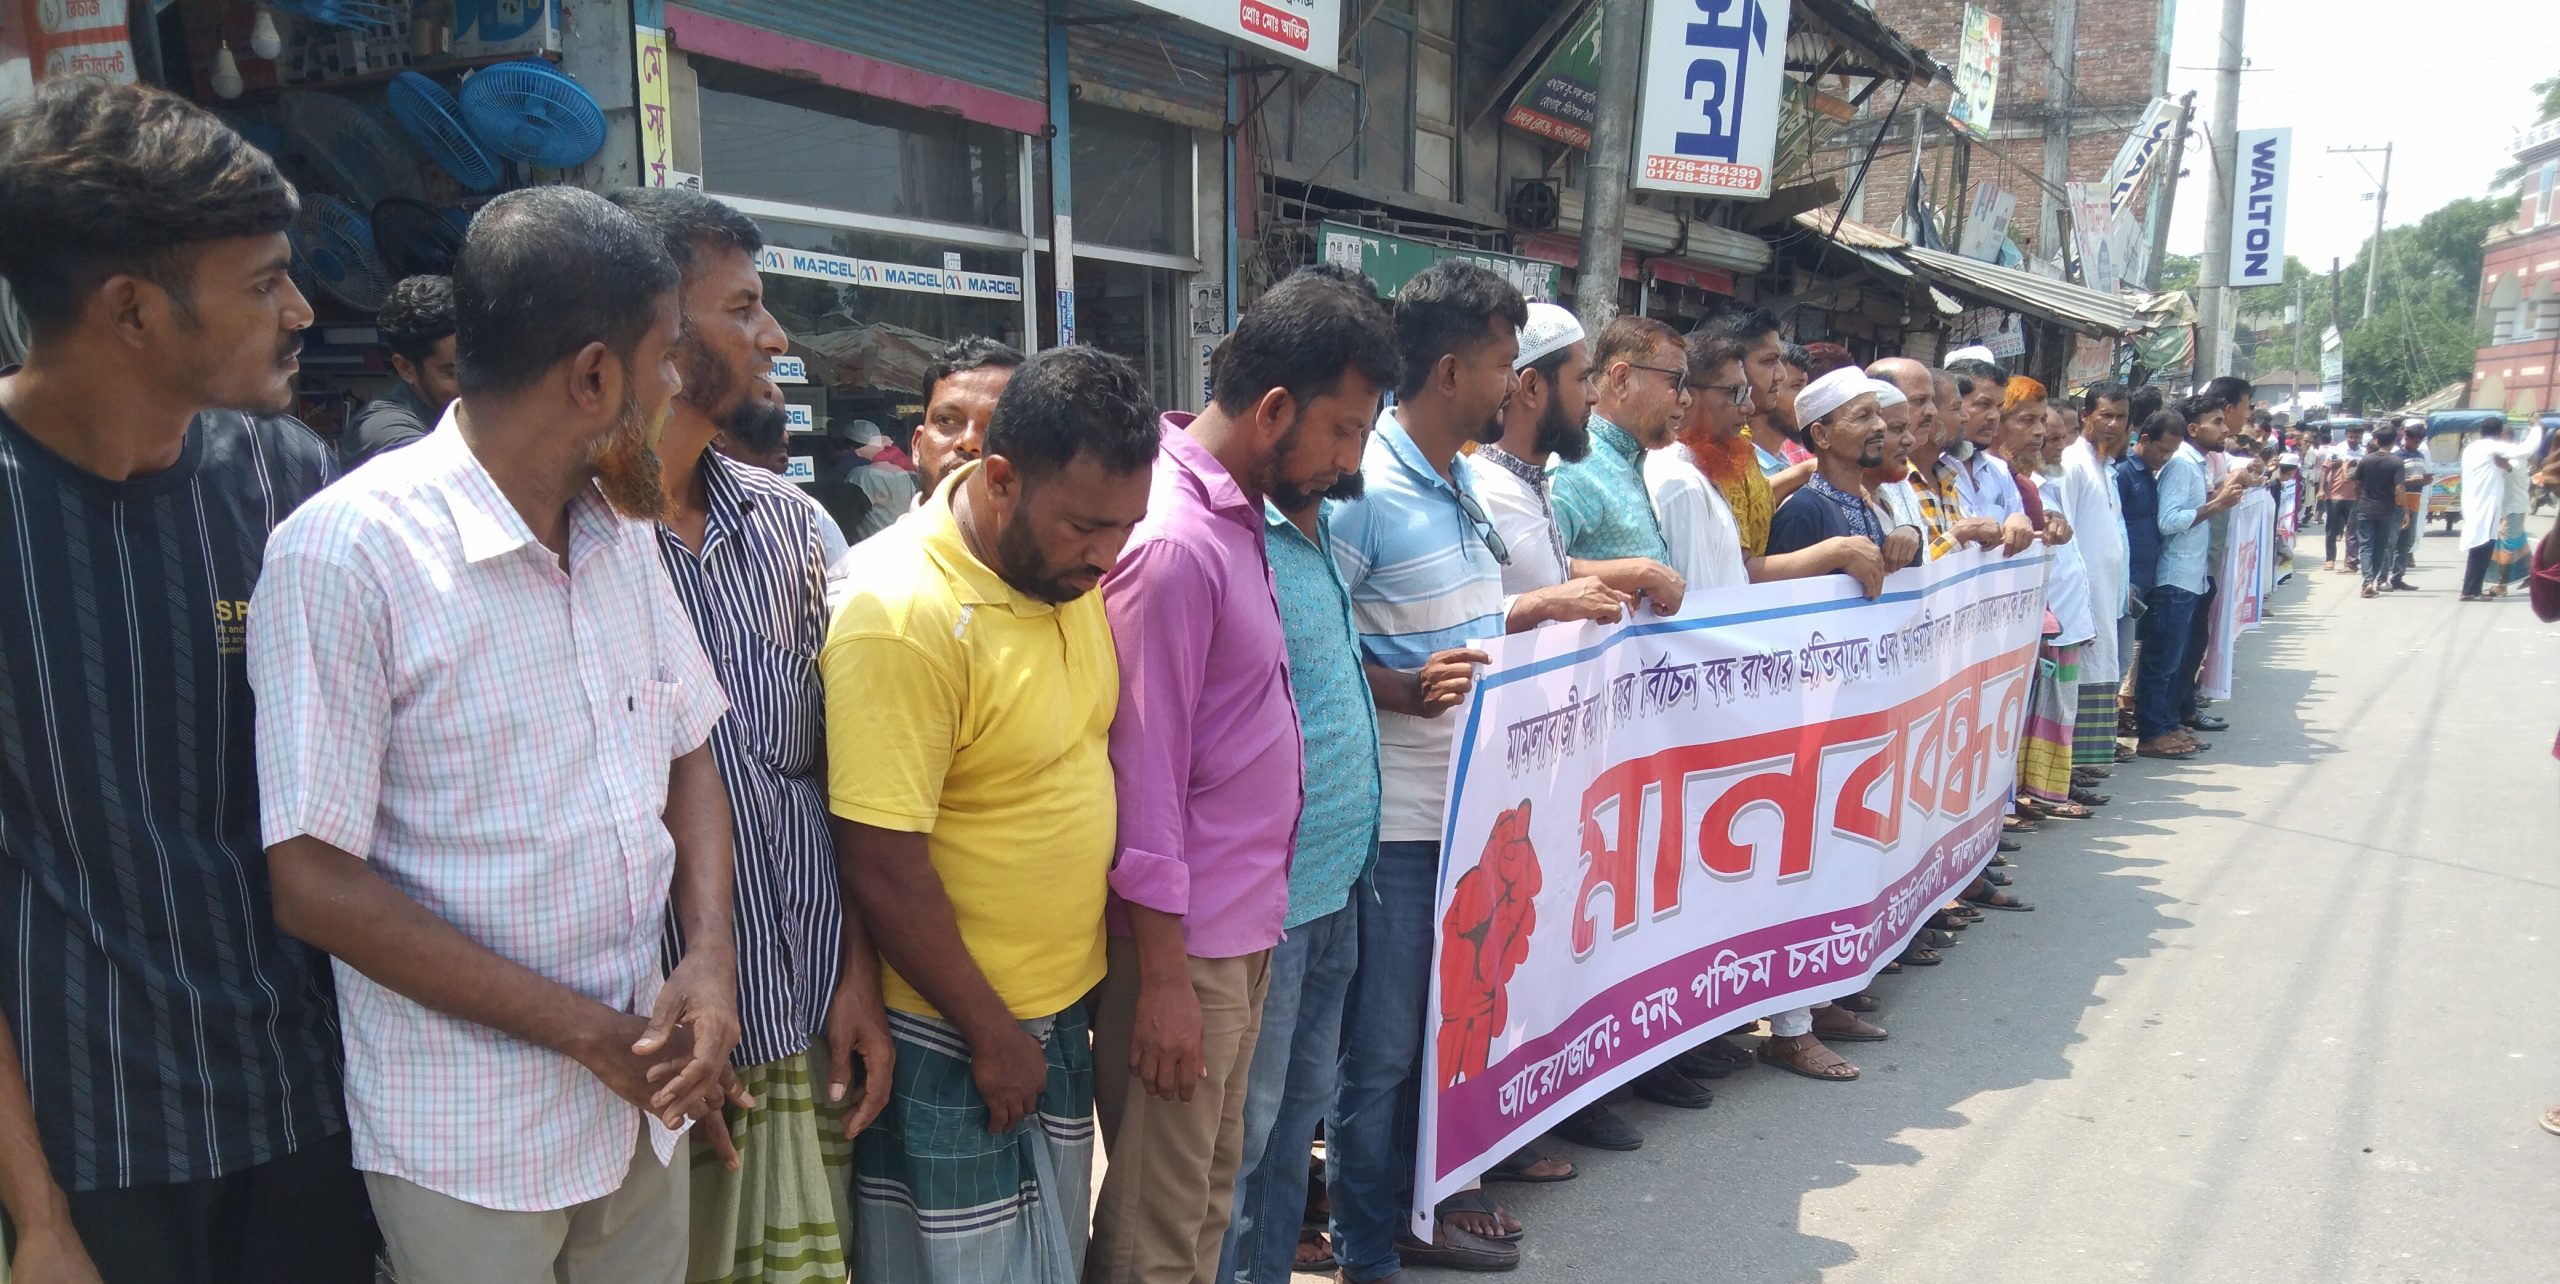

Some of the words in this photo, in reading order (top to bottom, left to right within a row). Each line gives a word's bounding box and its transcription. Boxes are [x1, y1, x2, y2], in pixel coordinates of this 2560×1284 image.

[1646, 168, 1756, 189] 01788-551291
[1647, 157, 1758, 179] 01756-484399
[2111, 119, 2172, 216] WAL
[2244, 137, 2277, 277] WALTON
[793, 256, 856, 278] MARCEL
[885, 268, 942, 288] MARCEL
[968, 277, 1020, 295] MARCEL
[770, 362, 806, 377] RCEL
[785, 411, 810, 424] CEL
[784, 463, 812, 476] CEL
[216, 600, 250, 621] SP
[1640, 651, 1697, 708] ির্বাচন
[1702, 658, 1737, 703] বন্ধ
[1741, 650, 1795, 694] রাখার
[1800, 631, 1872, 685] প্রতিবাদে
[1570, 643, 2036, 958] মানববন্ধন
[1631, 987, 1682, 1039] ৭নং
[1691, 949, 1777, 1008] পশ্চিম
[1784, 911, 1886, 979] চরউমেদ
